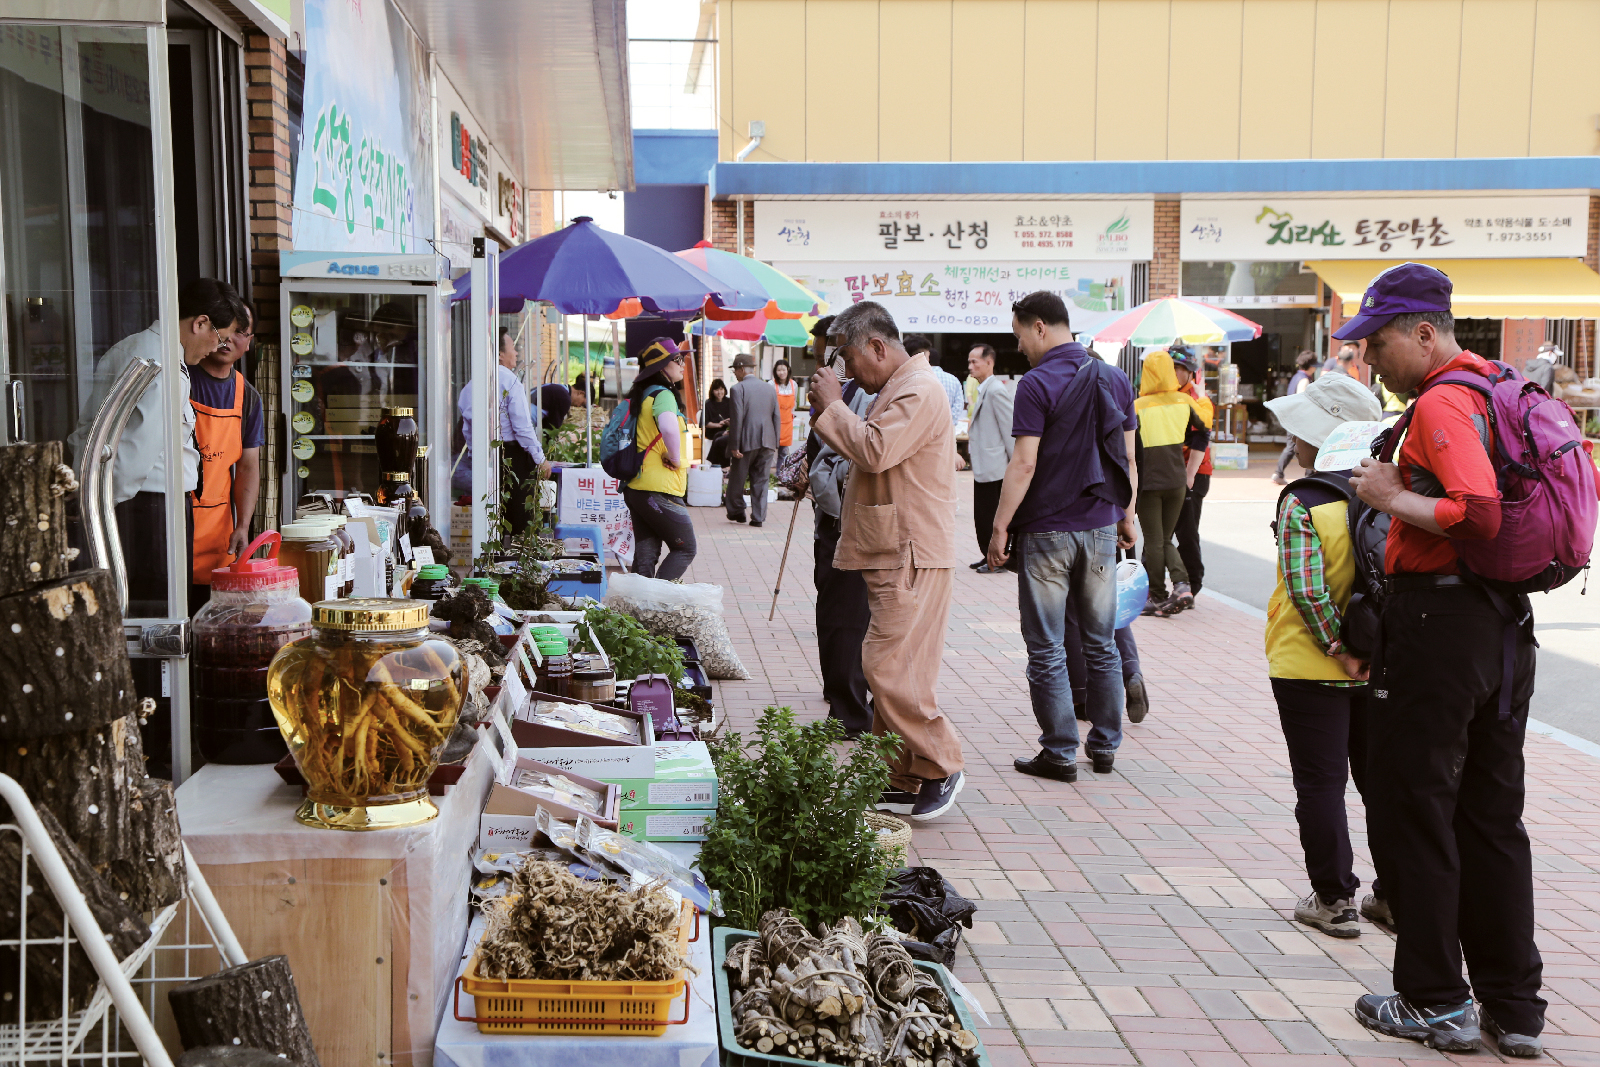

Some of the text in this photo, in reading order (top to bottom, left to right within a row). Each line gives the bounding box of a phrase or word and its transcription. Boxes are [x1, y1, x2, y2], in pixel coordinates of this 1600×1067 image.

[777, 226, 811, 246] 산청
[1266, 216, 1455, 252] 지리산 토종약초
[327, 261, 431, 277] Aqua FUN
[1016, 266, 1071, 280] 다이어트
[944, 288, 970, 310] 현장
[974, 291, 1003, 307] 20%
[926, 315, 998, 325] 1600-0830
[576, 498, 601, 511] 바르는
